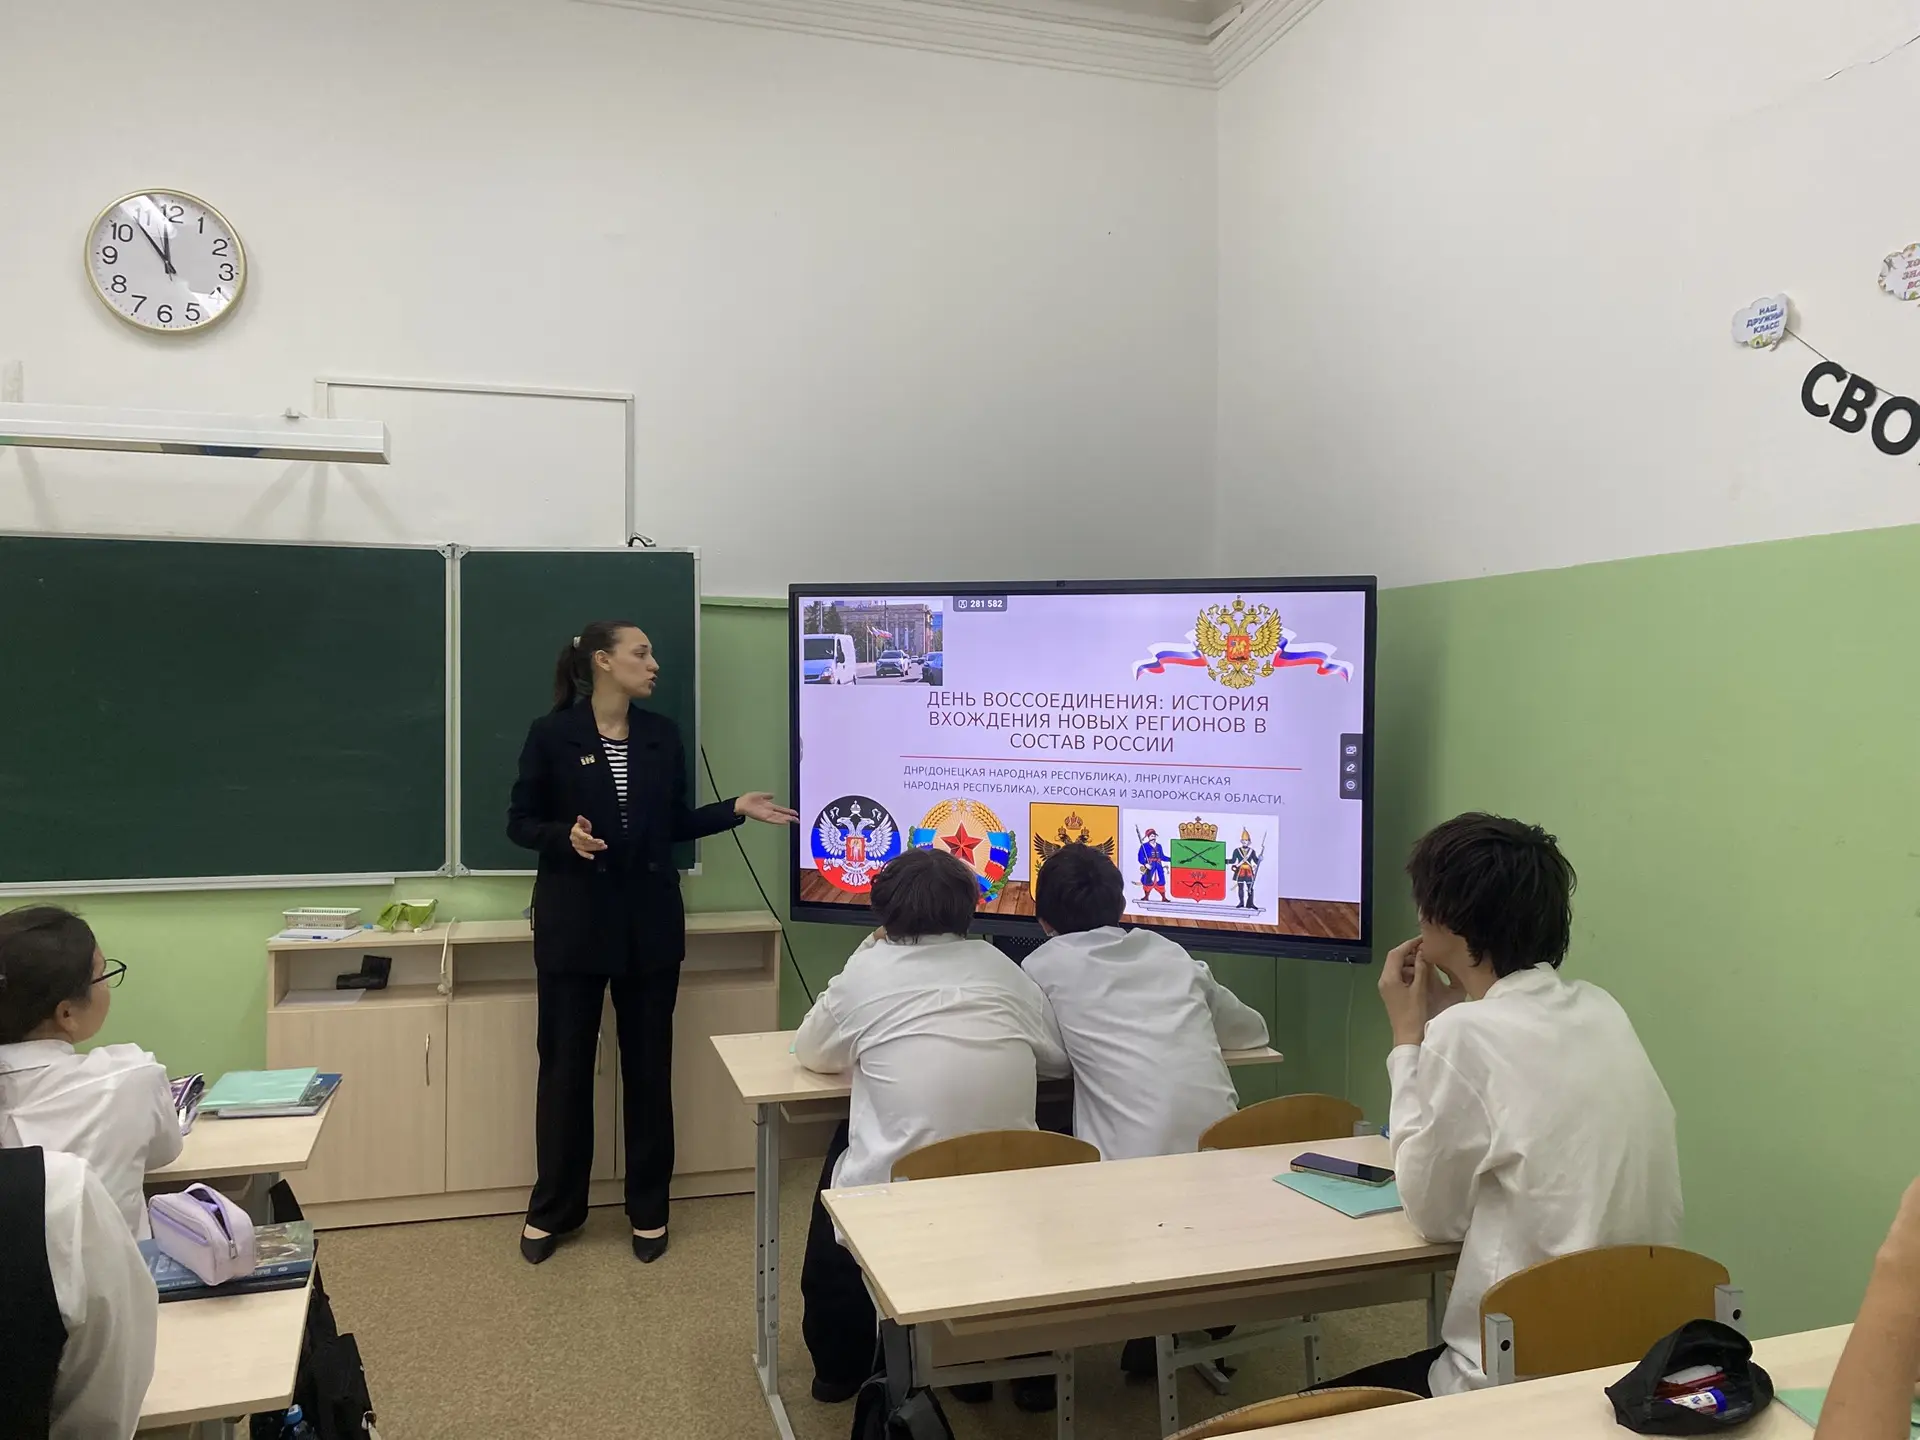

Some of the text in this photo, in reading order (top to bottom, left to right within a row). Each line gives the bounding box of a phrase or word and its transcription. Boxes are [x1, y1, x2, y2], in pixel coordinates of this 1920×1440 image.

[160, 204, 185, 224] 12
[111, 222, 133, 242] 10
[197, 216, 204, 234] 1
[102, 245, 118, 264] 9
[212, 238, 228, 257] 2
[218, 263, 234, 281] 3
[111, 274, 127, 293] 8
[131, 294, 147, 313] 7
[185, 302, 200, 321] 5
[1759, 304, 1777, 315] НАШ
[157, 304, 173, 323] 6
[1801, 361, 1920, 456] СВО
[970, 600, 1003, 608] 281 582
[927, 691, 1269, 712] ДЕНЬ ВОССОЕДИНЕНИЯ: ИСТОРИЯ
[929, 711, 1267, 733] ВХОЖДЕНИЯ НОВЫХ РЕГИОНОВ В
[1010, 733, 1174, 752] СОСТАВ РОССИИ
[903, 765, 1231, 786] ДНР(ДОНЕЦКАЯ НАРОДНАЯ РЕСПУБЛИКА), ЛНР(ЛУГАНСКАЯ
[903, 781, 959, 792] НАРОДНАЯ
[1043, 786, 1116, 798] ХЕРСОНСКАЯ
[1120, 788, 1127, 798] И
[1131, 789, 1221, 801] ЗАПОРОЖСКАЯ
[1224, 792, 1285, 805] ОБЛАСТИ.
